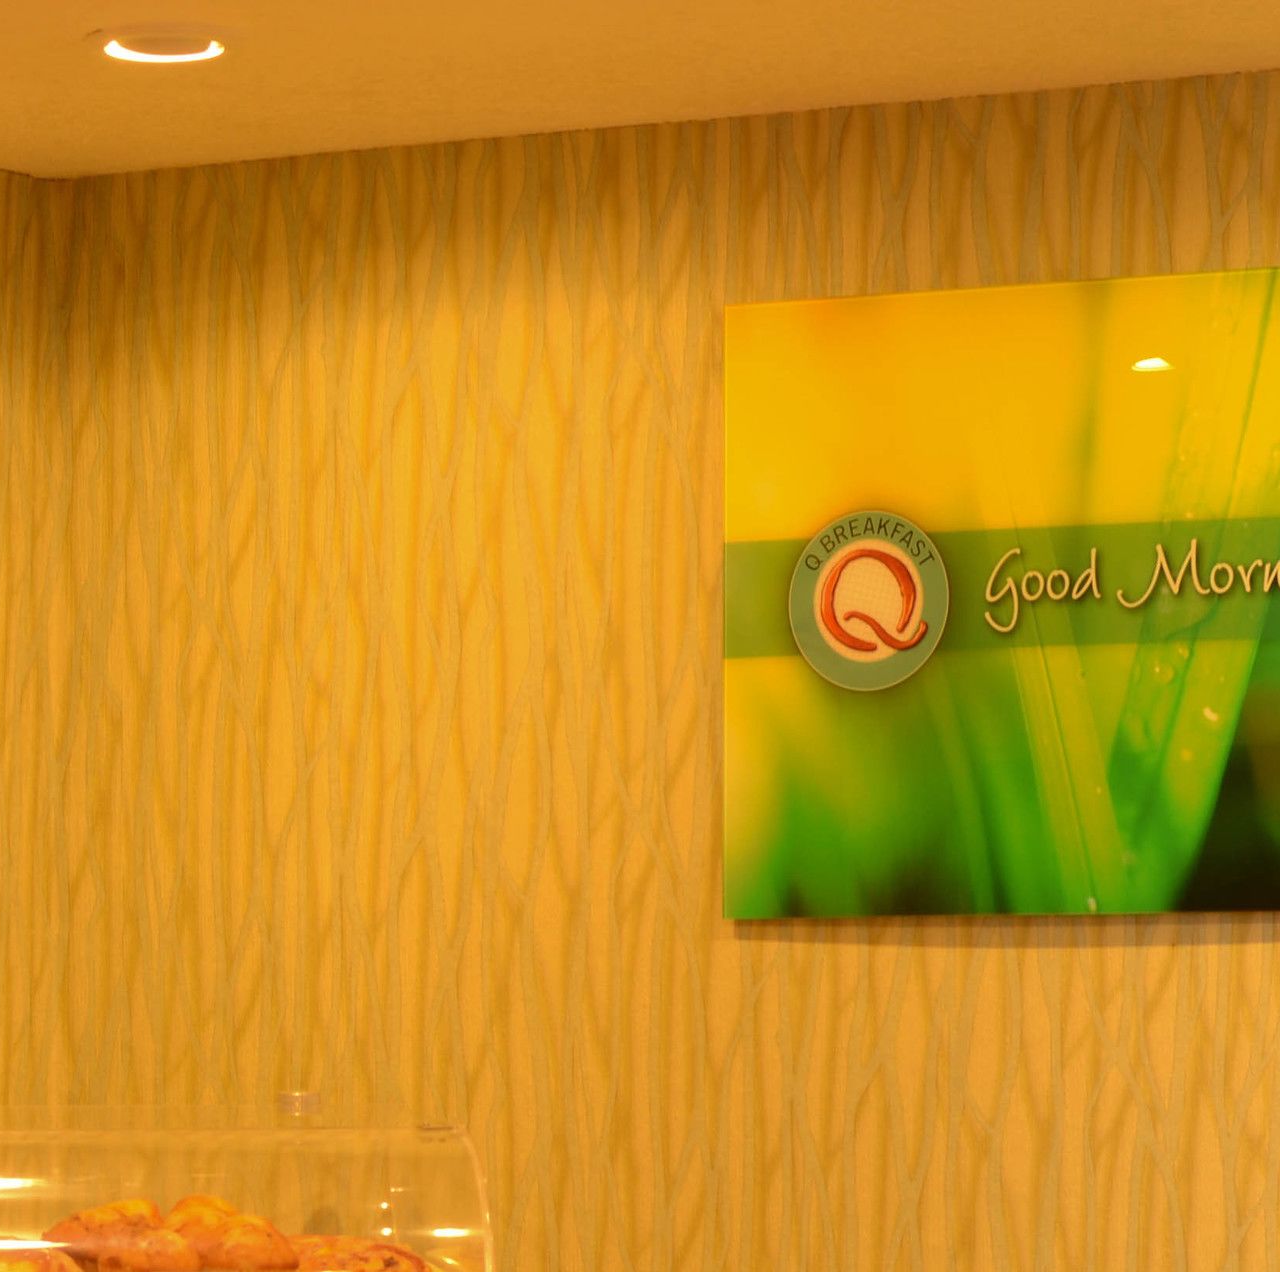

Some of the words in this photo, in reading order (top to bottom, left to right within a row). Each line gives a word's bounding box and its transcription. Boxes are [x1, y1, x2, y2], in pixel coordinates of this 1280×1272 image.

[804, 553, 823, 571] Q
[820, 517, 936, 566] BREAKFAST
[821, 548, 929, 652] Q
[984, 547, 1102, 633] Good
